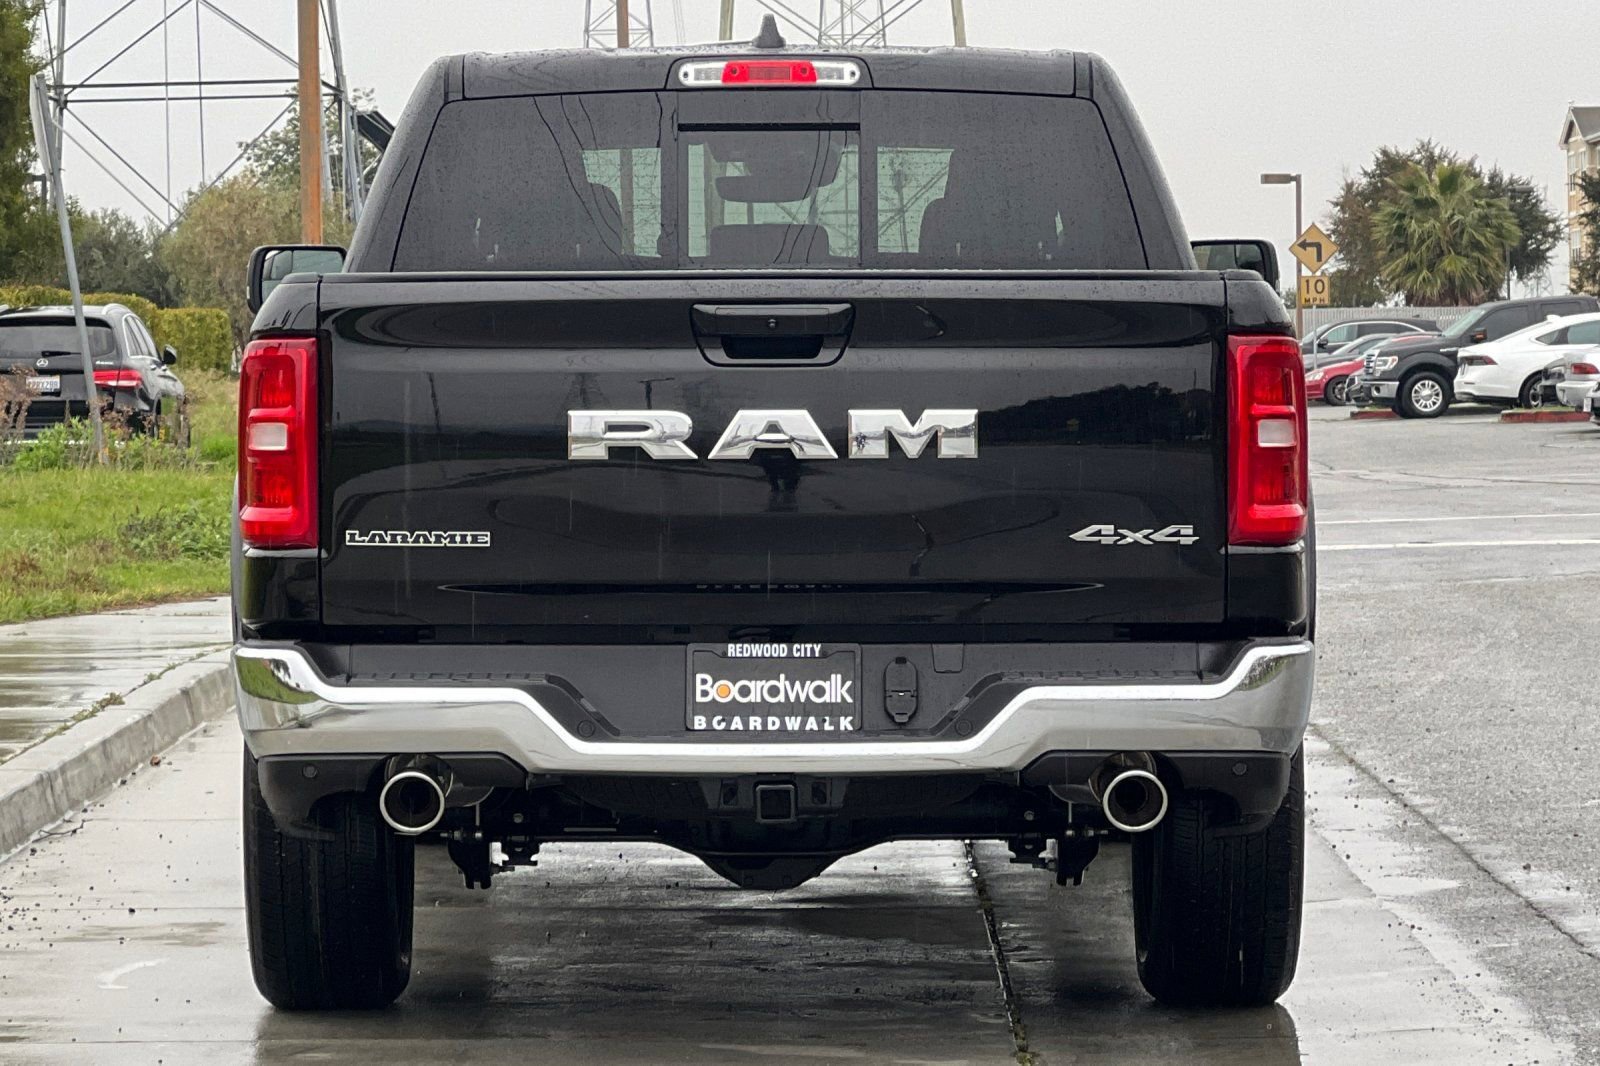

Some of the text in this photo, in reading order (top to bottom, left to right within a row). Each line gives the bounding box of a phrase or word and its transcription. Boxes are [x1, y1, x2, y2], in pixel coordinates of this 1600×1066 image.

[1305, 279, 1325, 294] 10
[567, 409, 979, 460] RAM
[346, 530, 491, 547] LARAMIE
[1068, 524, 1200, 545] 4x4
[727, 643, 822, 658] REDWOOD CITY
[695, 673, 854, 704] Boardwalk
[693, 715, 854, 732] BOARDWALK
